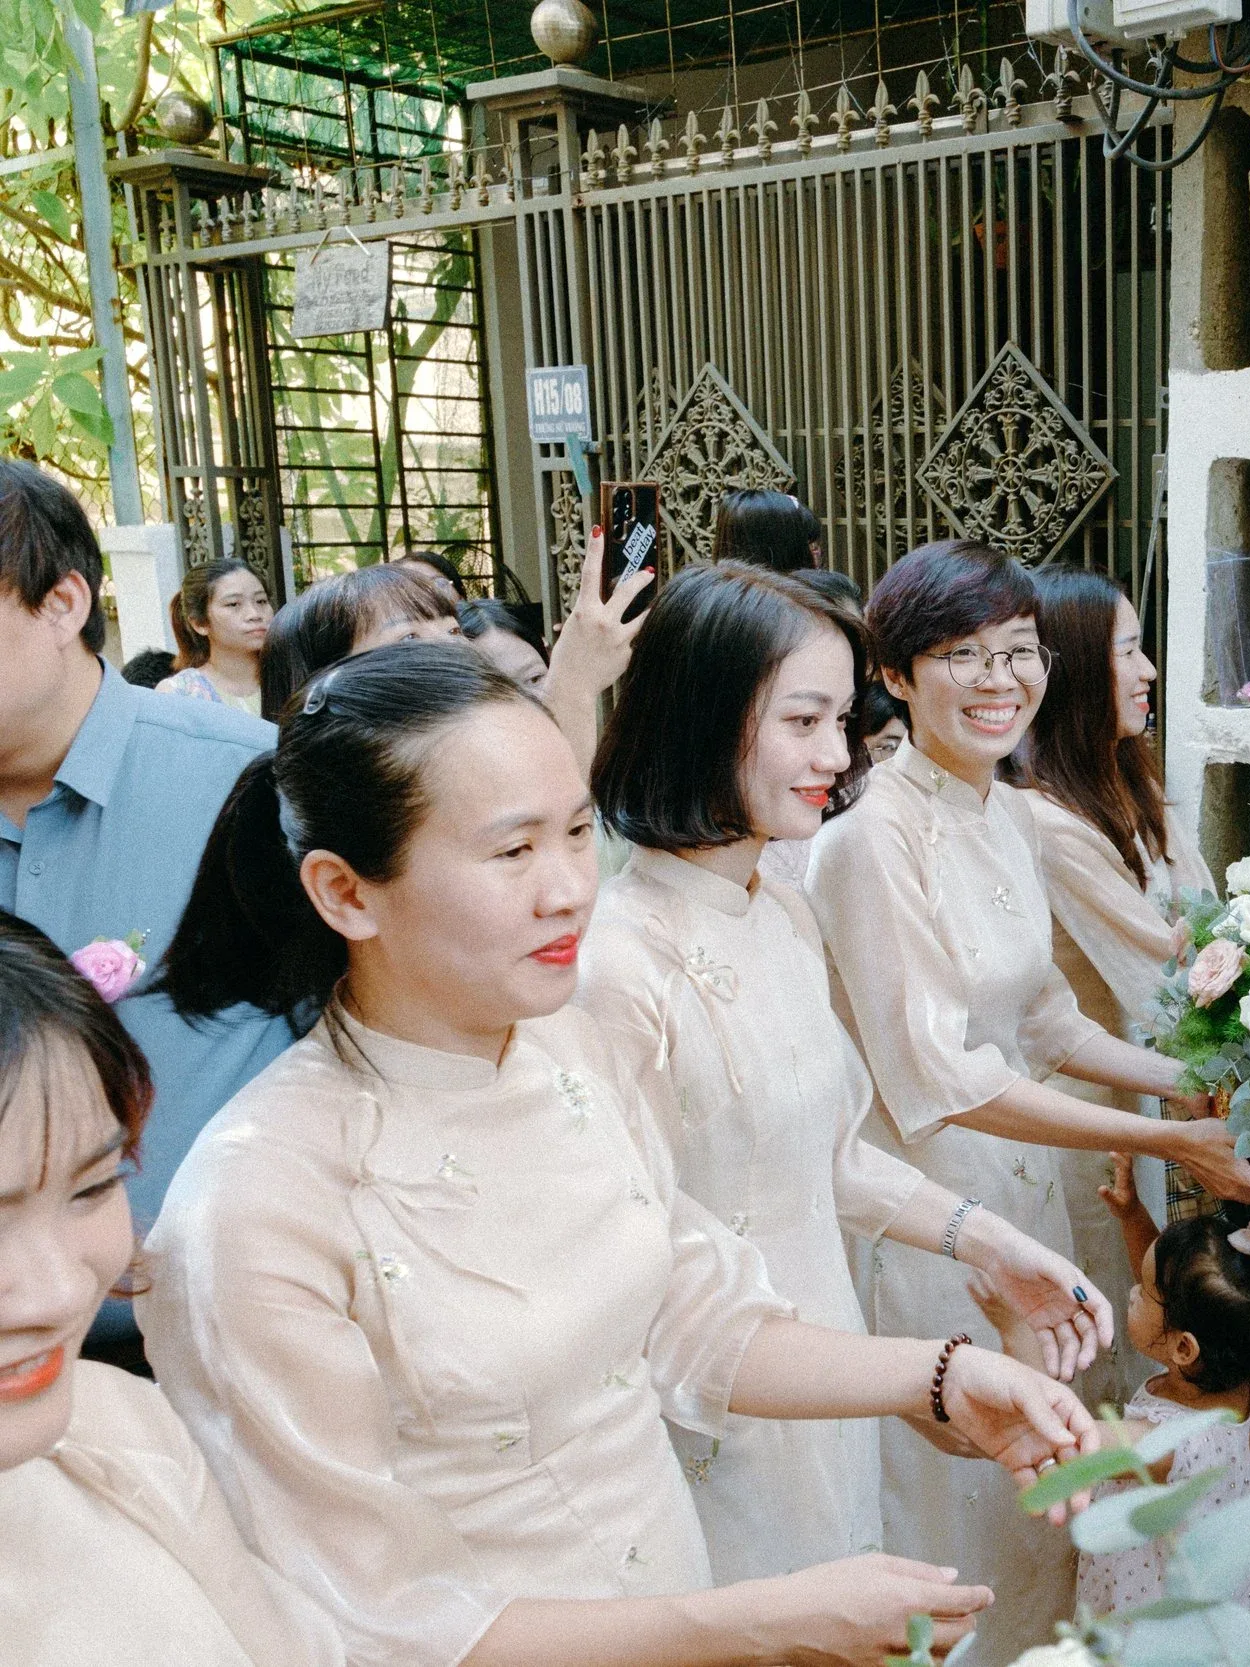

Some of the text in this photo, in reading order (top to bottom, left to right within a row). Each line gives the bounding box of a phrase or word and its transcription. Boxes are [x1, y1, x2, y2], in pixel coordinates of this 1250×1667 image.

[533, 375, 583, 416] H15/08
[621, 529, 656, 583] esterday.
[623, 526, 644, 556] beat
